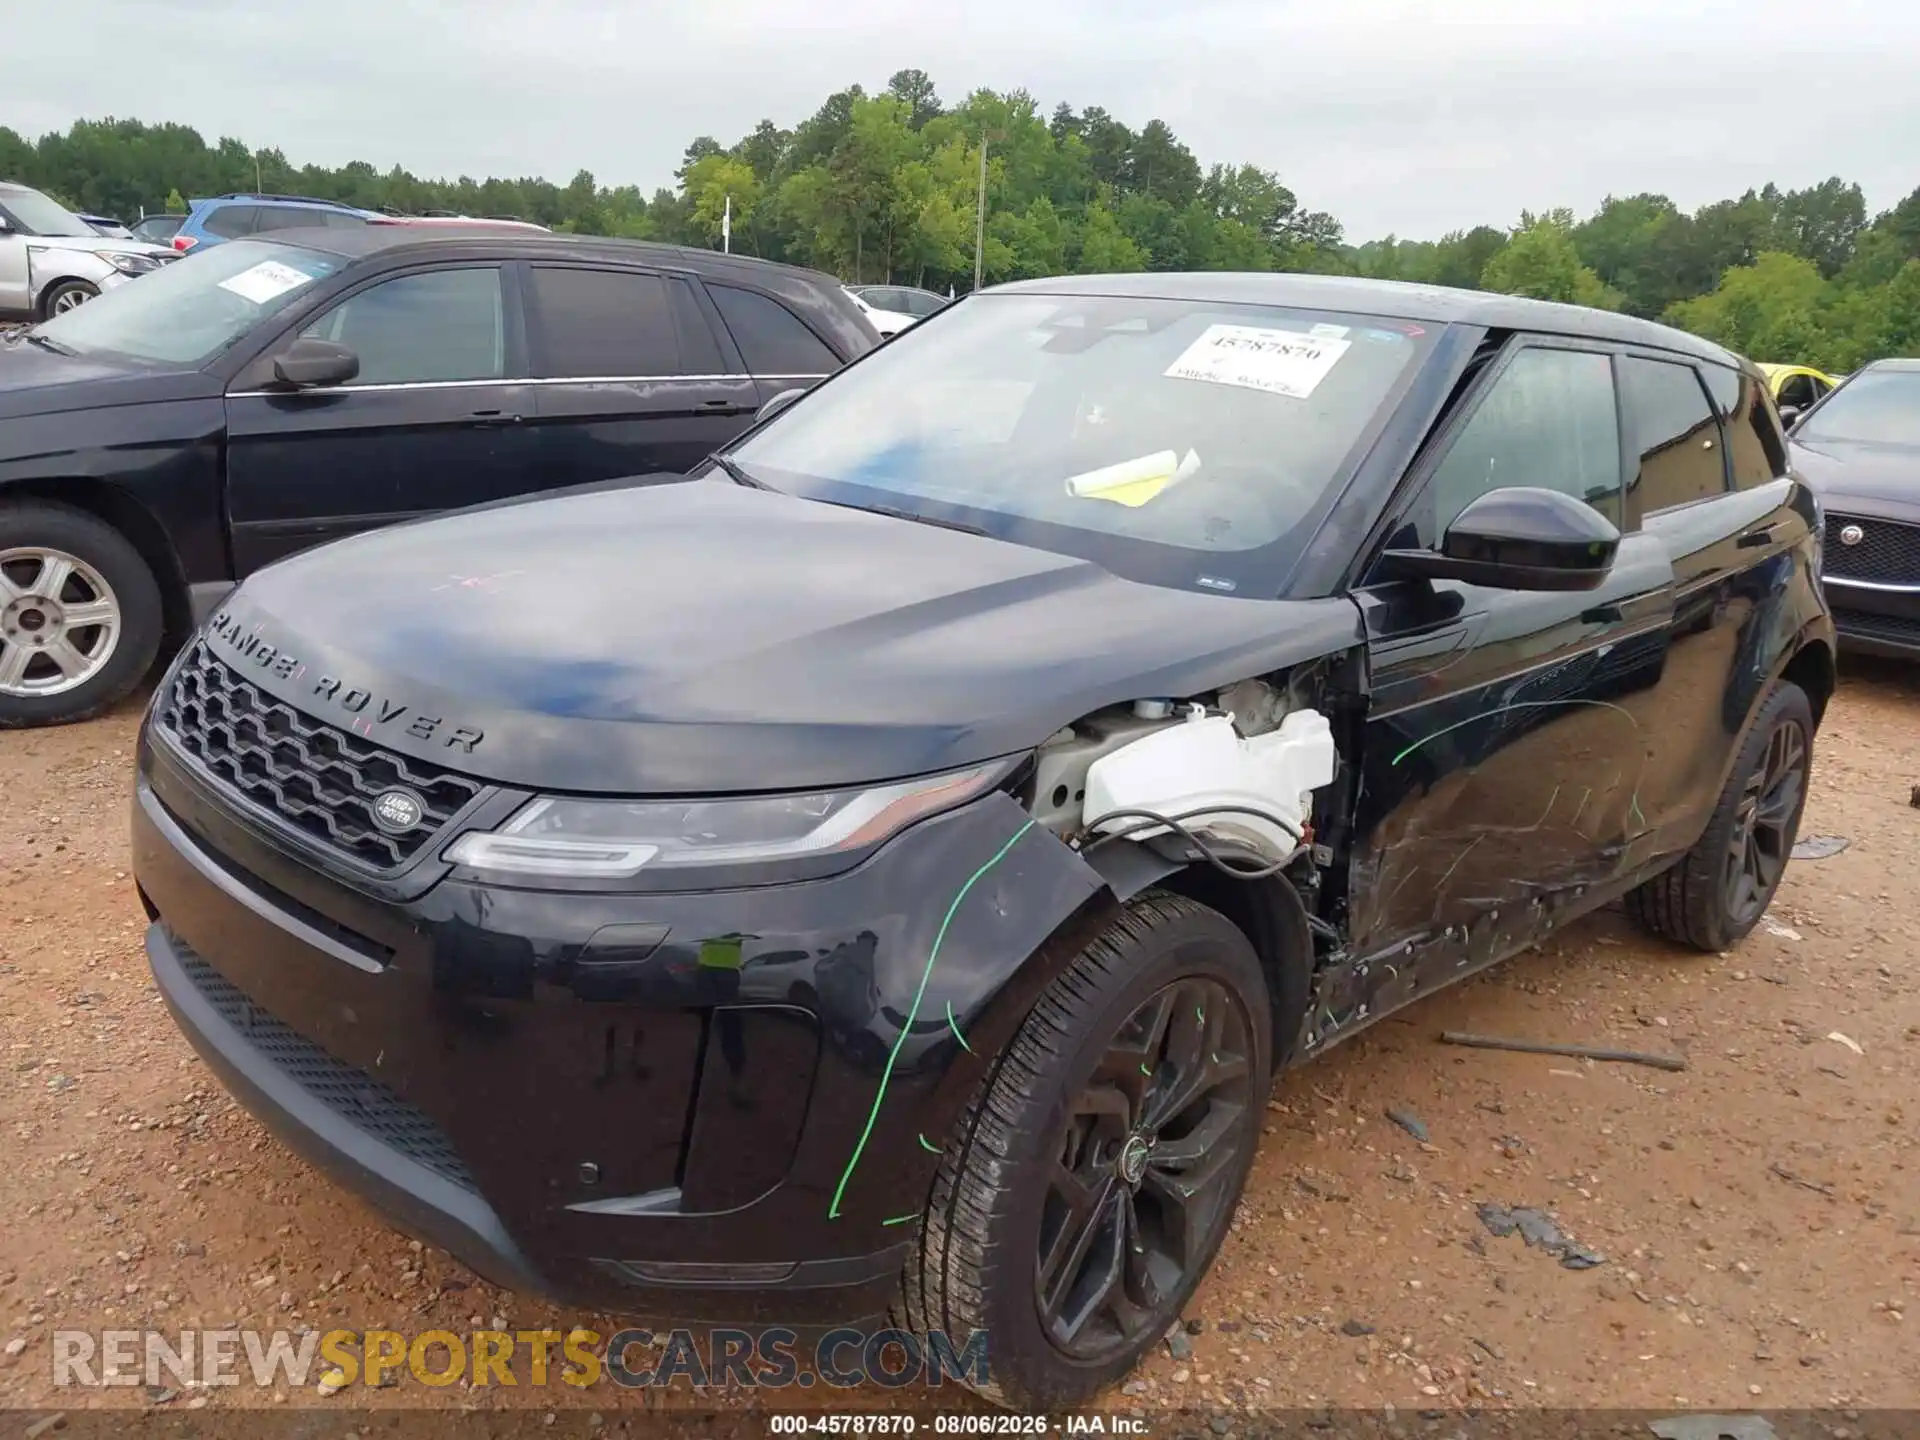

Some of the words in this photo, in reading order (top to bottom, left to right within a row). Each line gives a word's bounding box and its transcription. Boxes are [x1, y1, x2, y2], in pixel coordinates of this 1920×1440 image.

[1210, 336, 1322, 361] 45787870
[211, 612, 298, 680] RANGE
[313, 673, 485, 753] ROVER
[382, 806, 411, 825] ROVER
